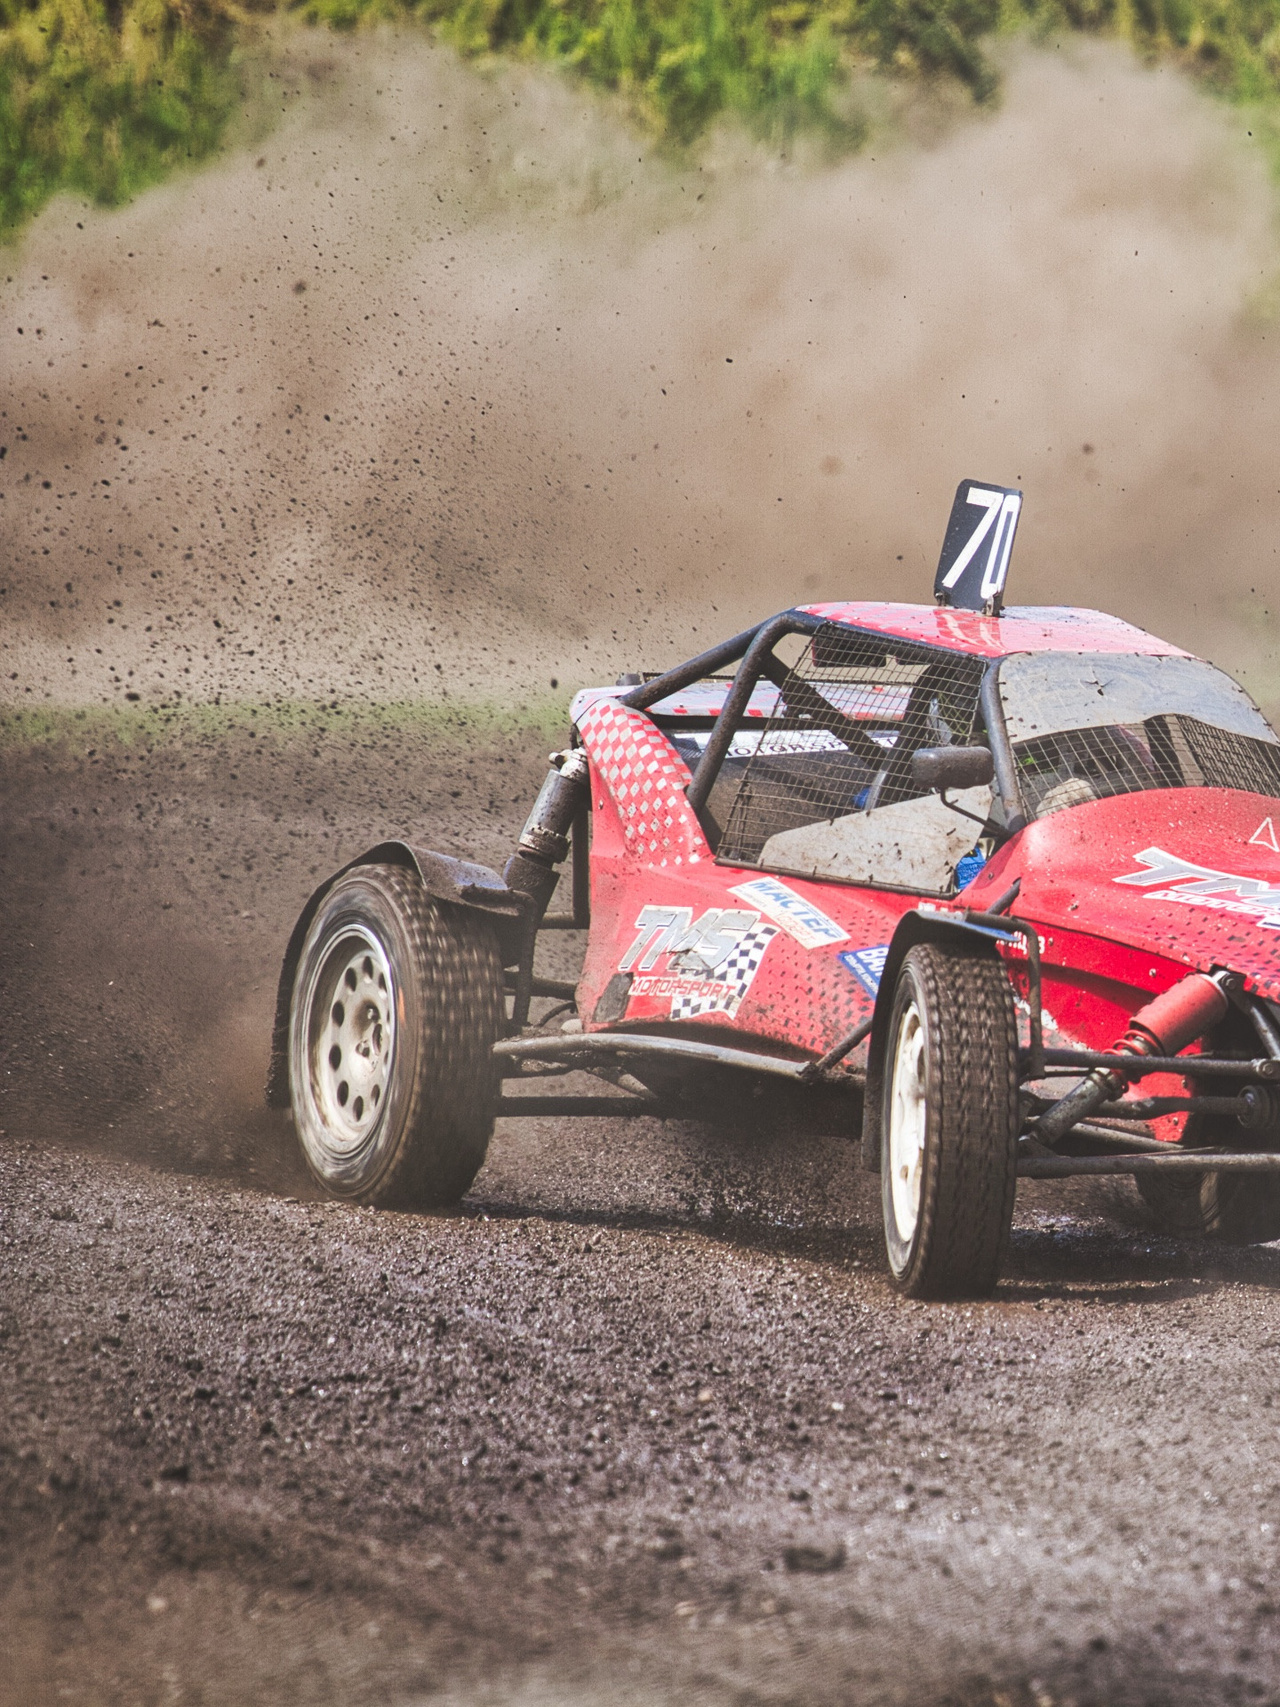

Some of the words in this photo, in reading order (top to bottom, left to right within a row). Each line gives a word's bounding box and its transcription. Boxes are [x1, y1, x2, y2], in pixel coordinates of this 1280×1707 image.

[941, 486, 1021, 599] 70
[617, 905, 762, 972] TMS
[629, 977, 737, 999] MOTORSPORT
